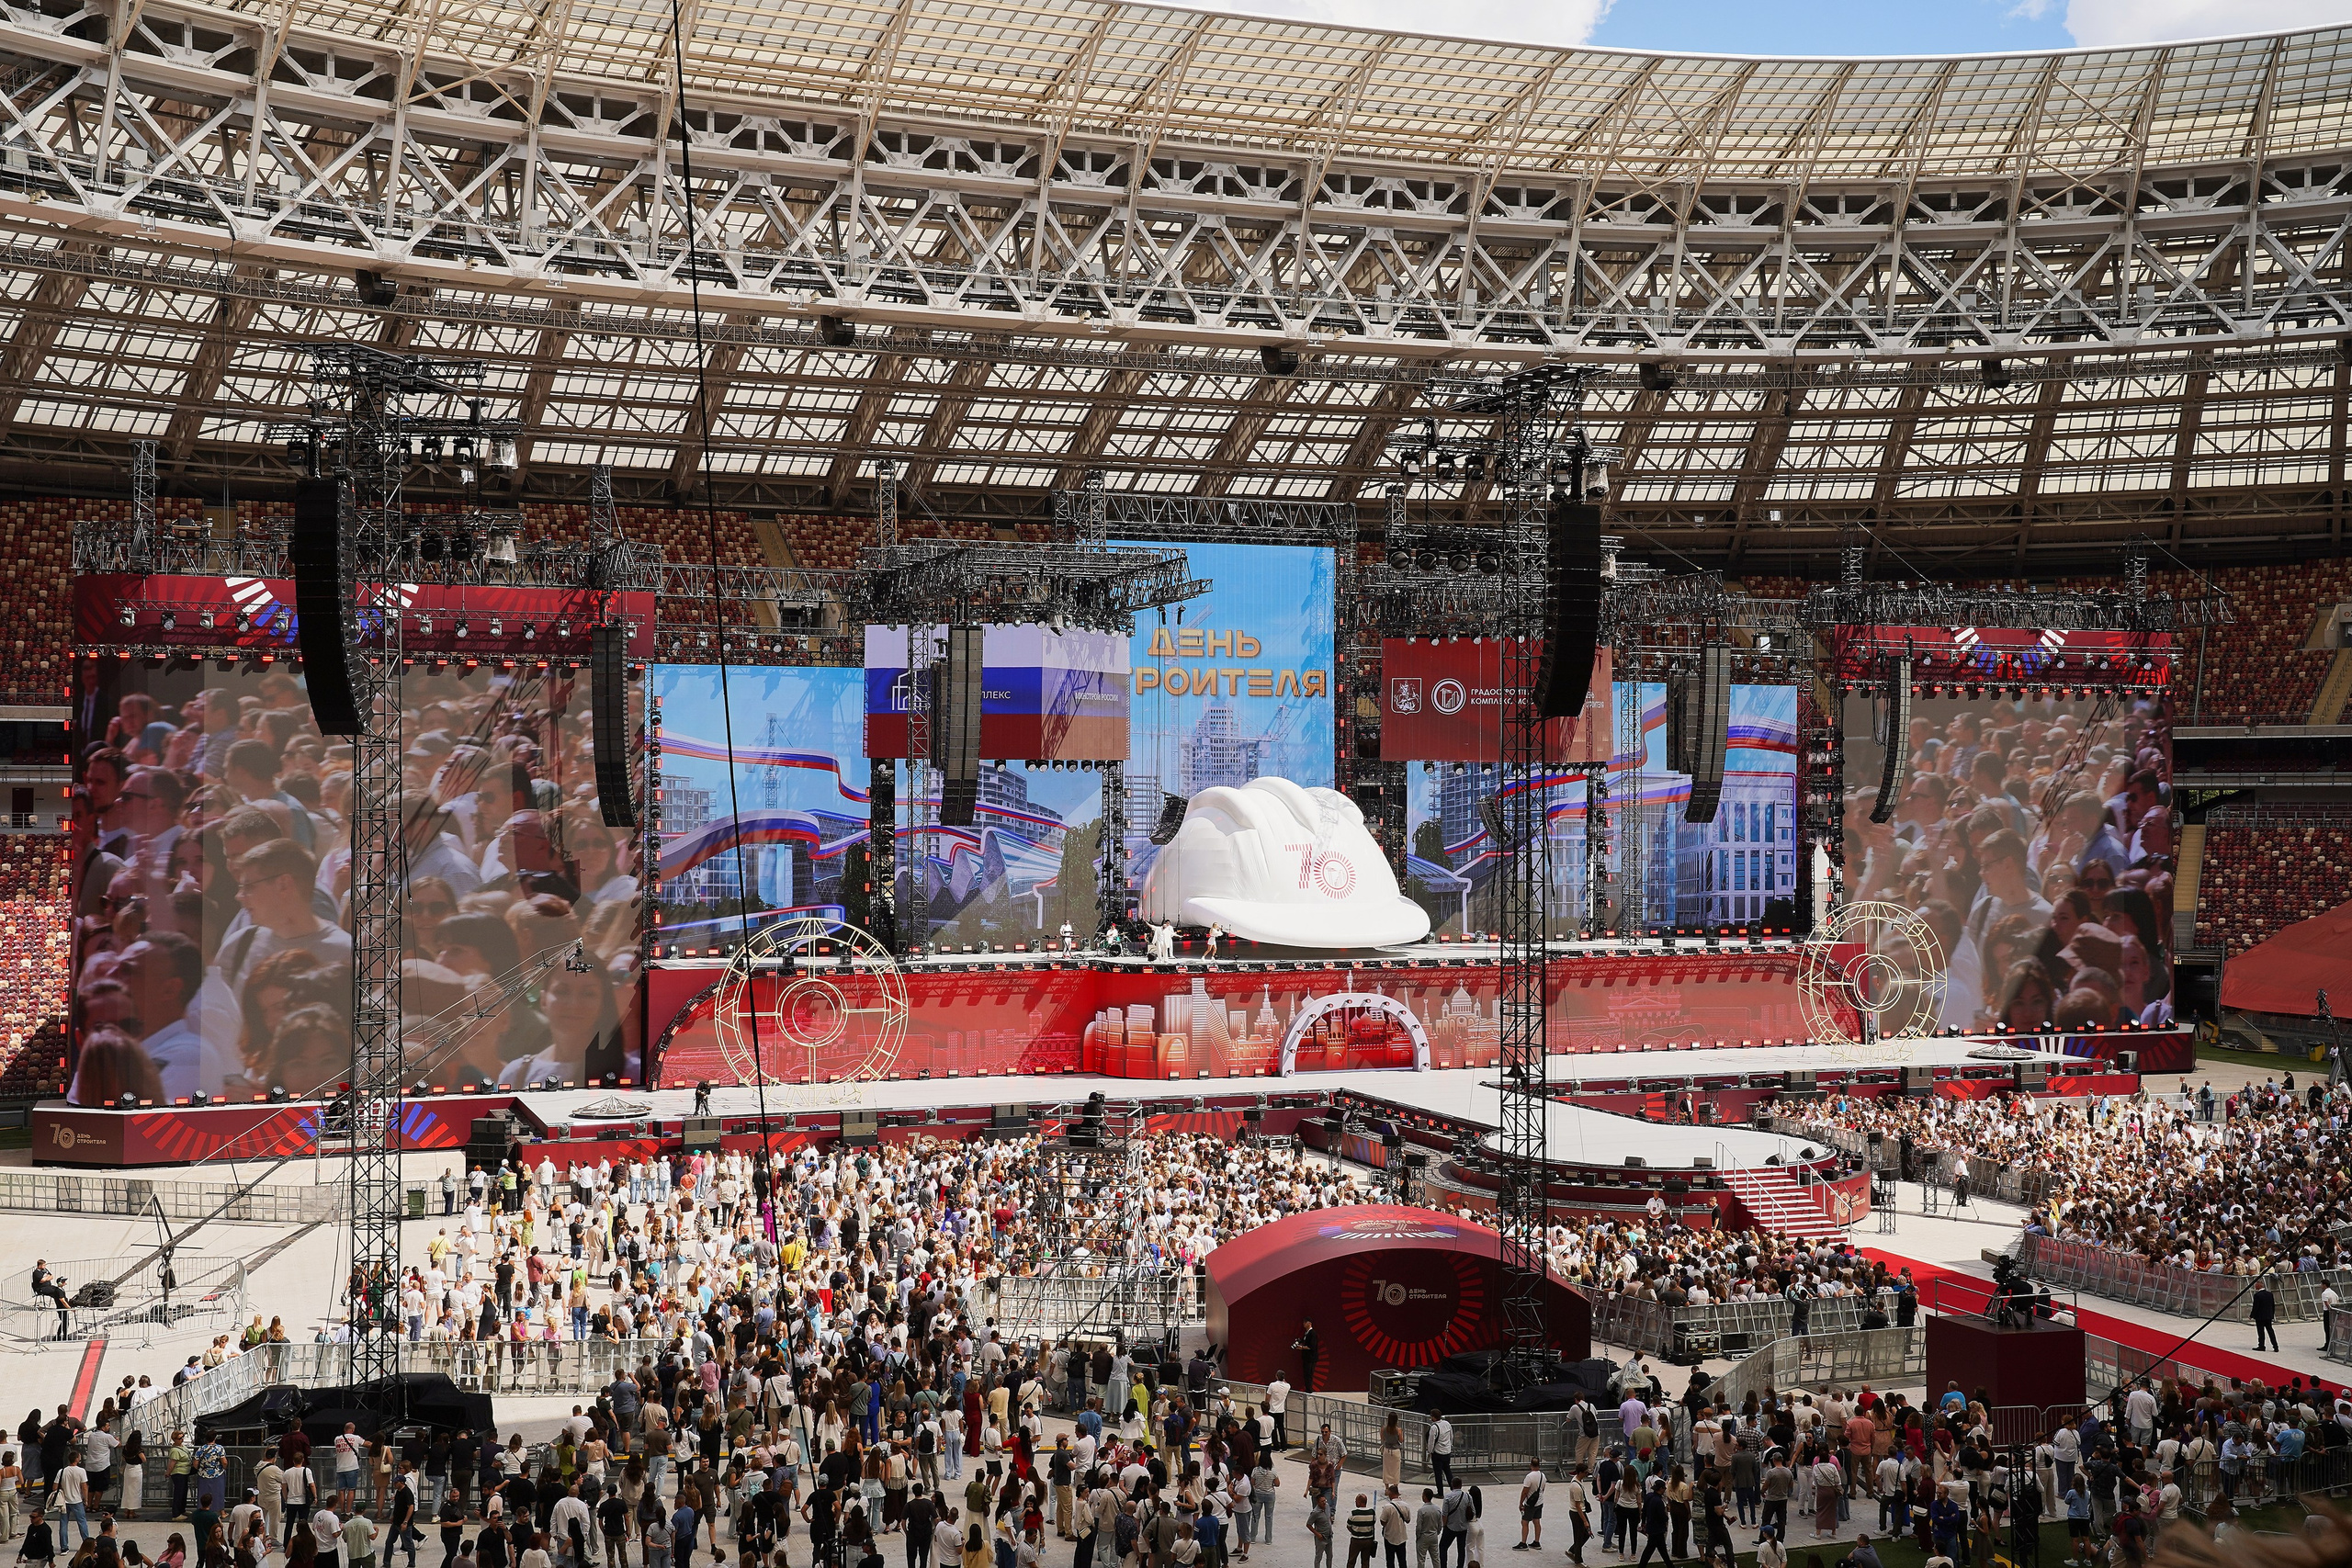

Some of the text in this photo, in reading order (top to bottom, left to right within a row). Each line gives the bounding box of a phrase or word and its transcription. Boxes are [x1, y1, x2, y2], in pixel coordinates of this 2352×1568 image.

[1148, 628, 1261, 658] ДЕНЬ
[1130, 667, 1326, 697] РОИТЕЛЯ
[50, 1123, 75, 1149] 70
[1373, 1280, 1407, 1305] 70
